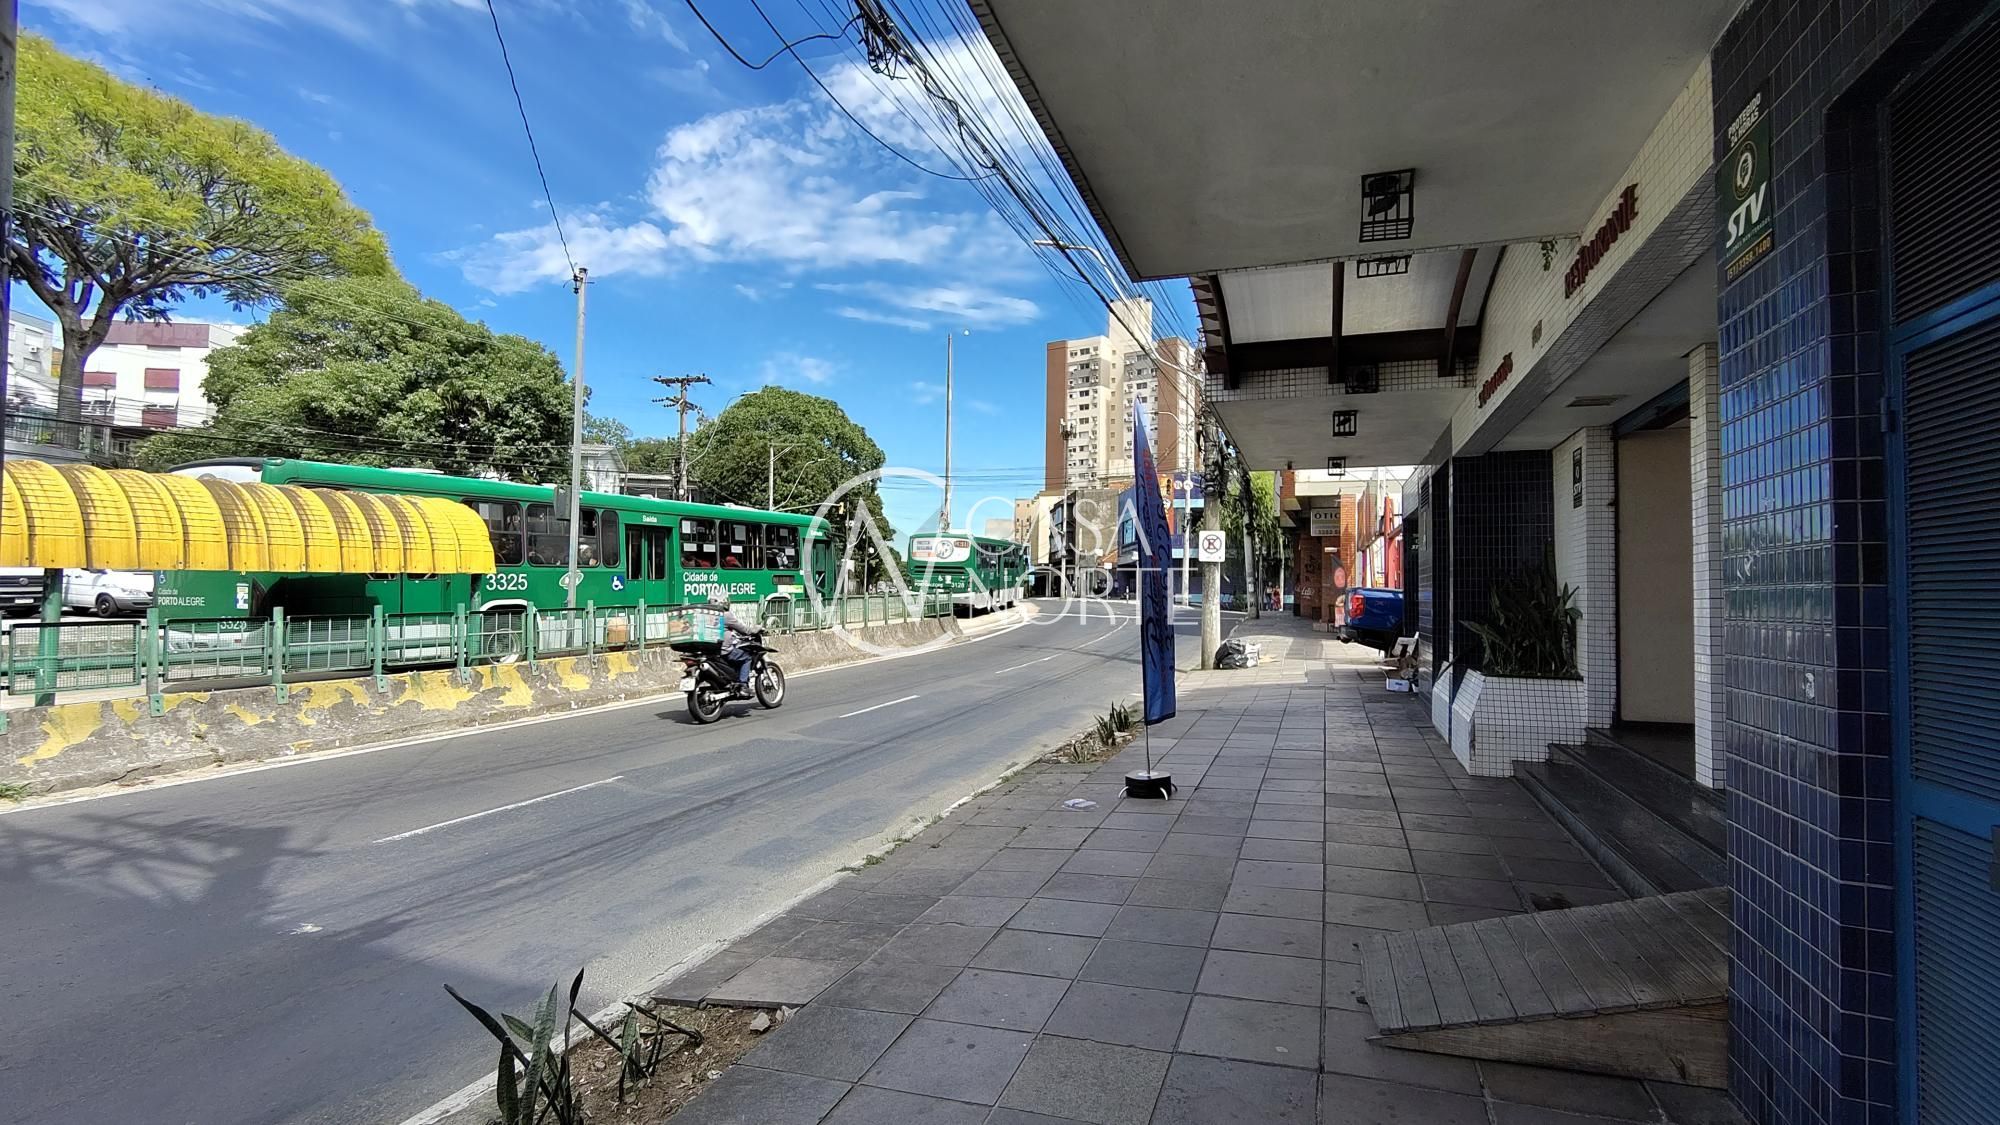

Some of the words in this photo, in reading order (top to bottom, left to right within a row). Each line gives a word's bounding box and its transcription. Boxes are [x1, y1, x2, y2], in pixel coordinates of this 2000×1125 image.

[1728, 92, 1761, 139] PROTEGIDO
[1738, 107, 1759, 139] HORAS
[1726, 181, 1767, 249] STV
[486, 573, 528, 591] 3325
[683, 571, 708, 582] Cidade
[709, 571, 718, 581] de
[684, 583, 721, 596] PORTO
[719, 582, 756, 595] ALEGRE
[157, 596, 178, 606] PORTO
[178, 596, 206, 607] ALEGRE
